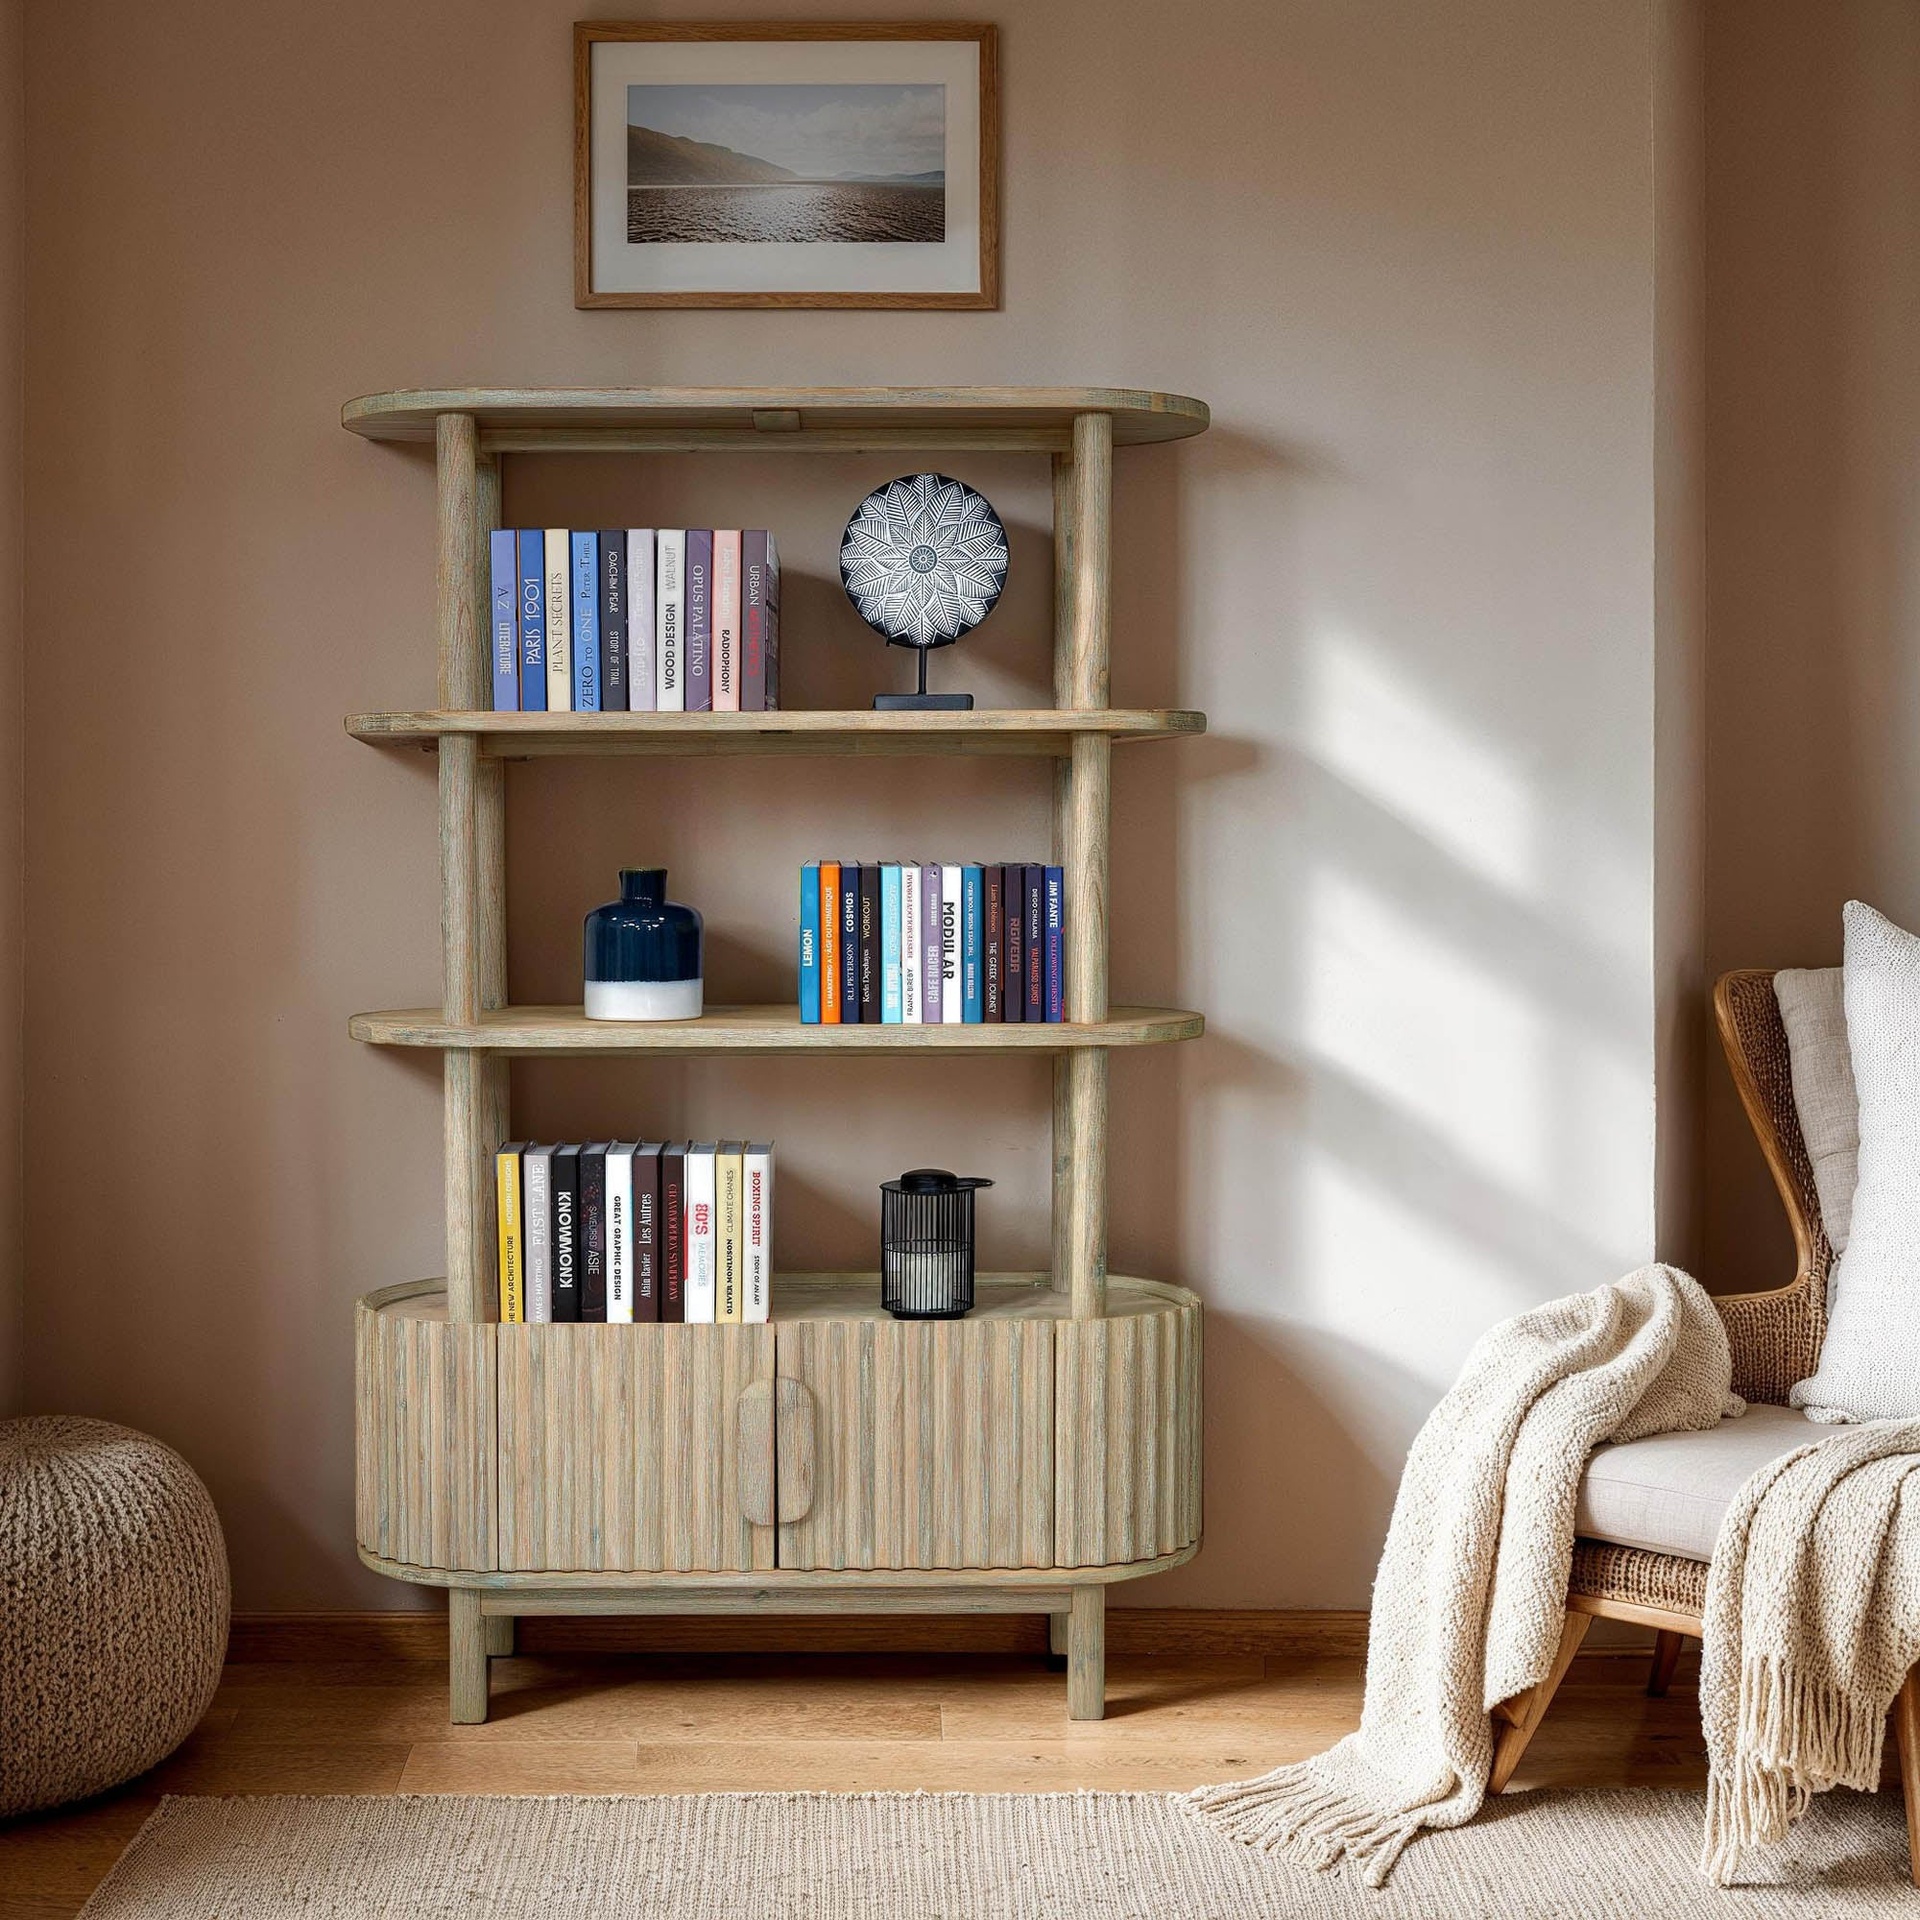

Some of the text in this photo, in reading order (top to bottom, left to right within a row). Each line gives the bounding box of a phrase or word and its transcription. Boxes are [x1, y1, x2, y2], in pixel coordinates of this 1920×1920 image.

[608, 551, 619, 614] JOACHIM PEAR
[665, 545, 676, 590] WALNUT
[749, 565, 760, 606] URBAN
[498, 600, 509, 610] Z
[525, 579, 541, 665] PARIS 1901
[551, 572, 564, 672] PLANT SECRETS
[581, 608, 592, 642] ONE
[692, 565, 704, 677] OPUS PALATINO
[498, 622, 511, 675] LITERATURE
[609, 631, 620, 687] STORY OF TRAIL
[664, 604, 676, 690] WOOD DESIGN
[721, 630, 731, 694] RADIOPHONY
[581, 667, 594, 707] ZERO
[846, 892, 854, 933] COSMOS
[862, 896, 871, 939] WORKOUT
[1049, 880, 1058, 928] JIM FANTE
[803, 929, 813, 967] LEMON
[942, 902, 955, 980] MODULAR
[846, 943, 855, 986] PETERSON
[927, 945, 939, 1003] CAFE RACER
[989, 942, 997, 1014] THE GREEK JOURNEY
[906, 993, 914, 1016] FRANK
[532, 1164, 546, 1246] FAST LANE
[638, 1193, 652, 1245] Les Autres
[695, 1203, 709, 1235] 80'S
[726, 1201, 734, 1234] CLIMATE
[752, 1171, 761, 1247] BOXING SPIRIT
[506, 1236, 515, 1292] ARCHITECTURE
[613, 1195, 622, 1301] GREAT GRAPHIC DESIGN
[697, 1242, 706, 1287] MEMORIES
[535, 1258, 543, 1295] HARTING
[640, 1253, 651, 1298] Alain Ravier
[753, 1275, 760, 1283] OF
[753, 1283, 760, 1293] AN
[508, 1313, 516, 1323] HE
